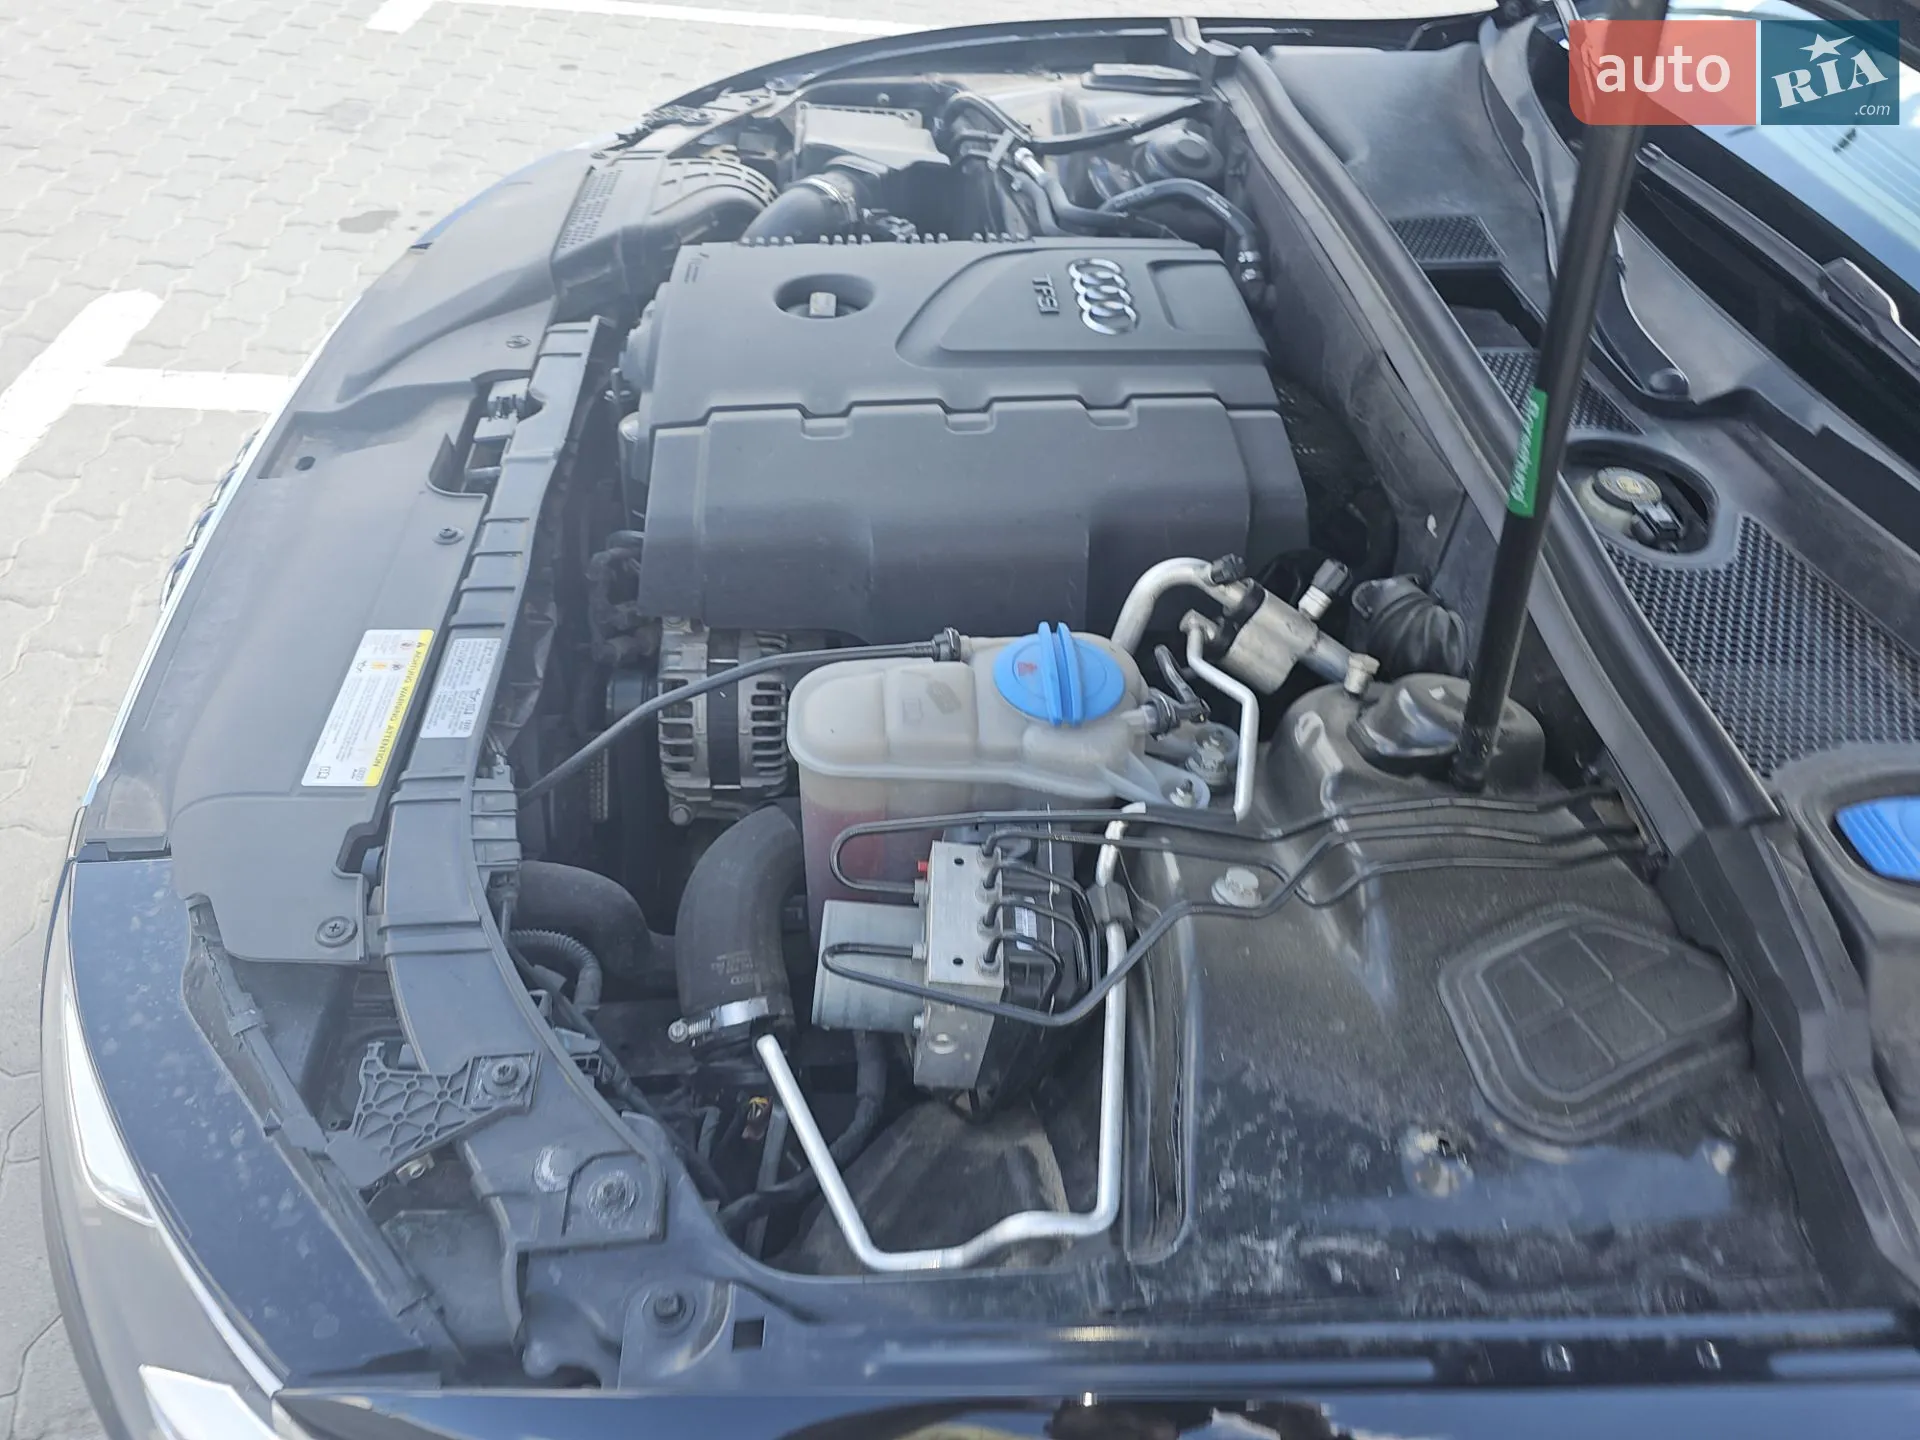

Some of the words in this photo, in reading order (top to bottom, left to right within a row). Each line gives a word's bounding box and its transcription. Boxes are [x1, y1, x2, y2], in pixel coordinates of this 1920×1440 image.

[1032, 271, 1060, 314] TFSI
[404, 649, 422, 684] ACHTUNG
[390, 685, 409, 724] WARNING
[373, 725, 395, 768] ATTENTION
